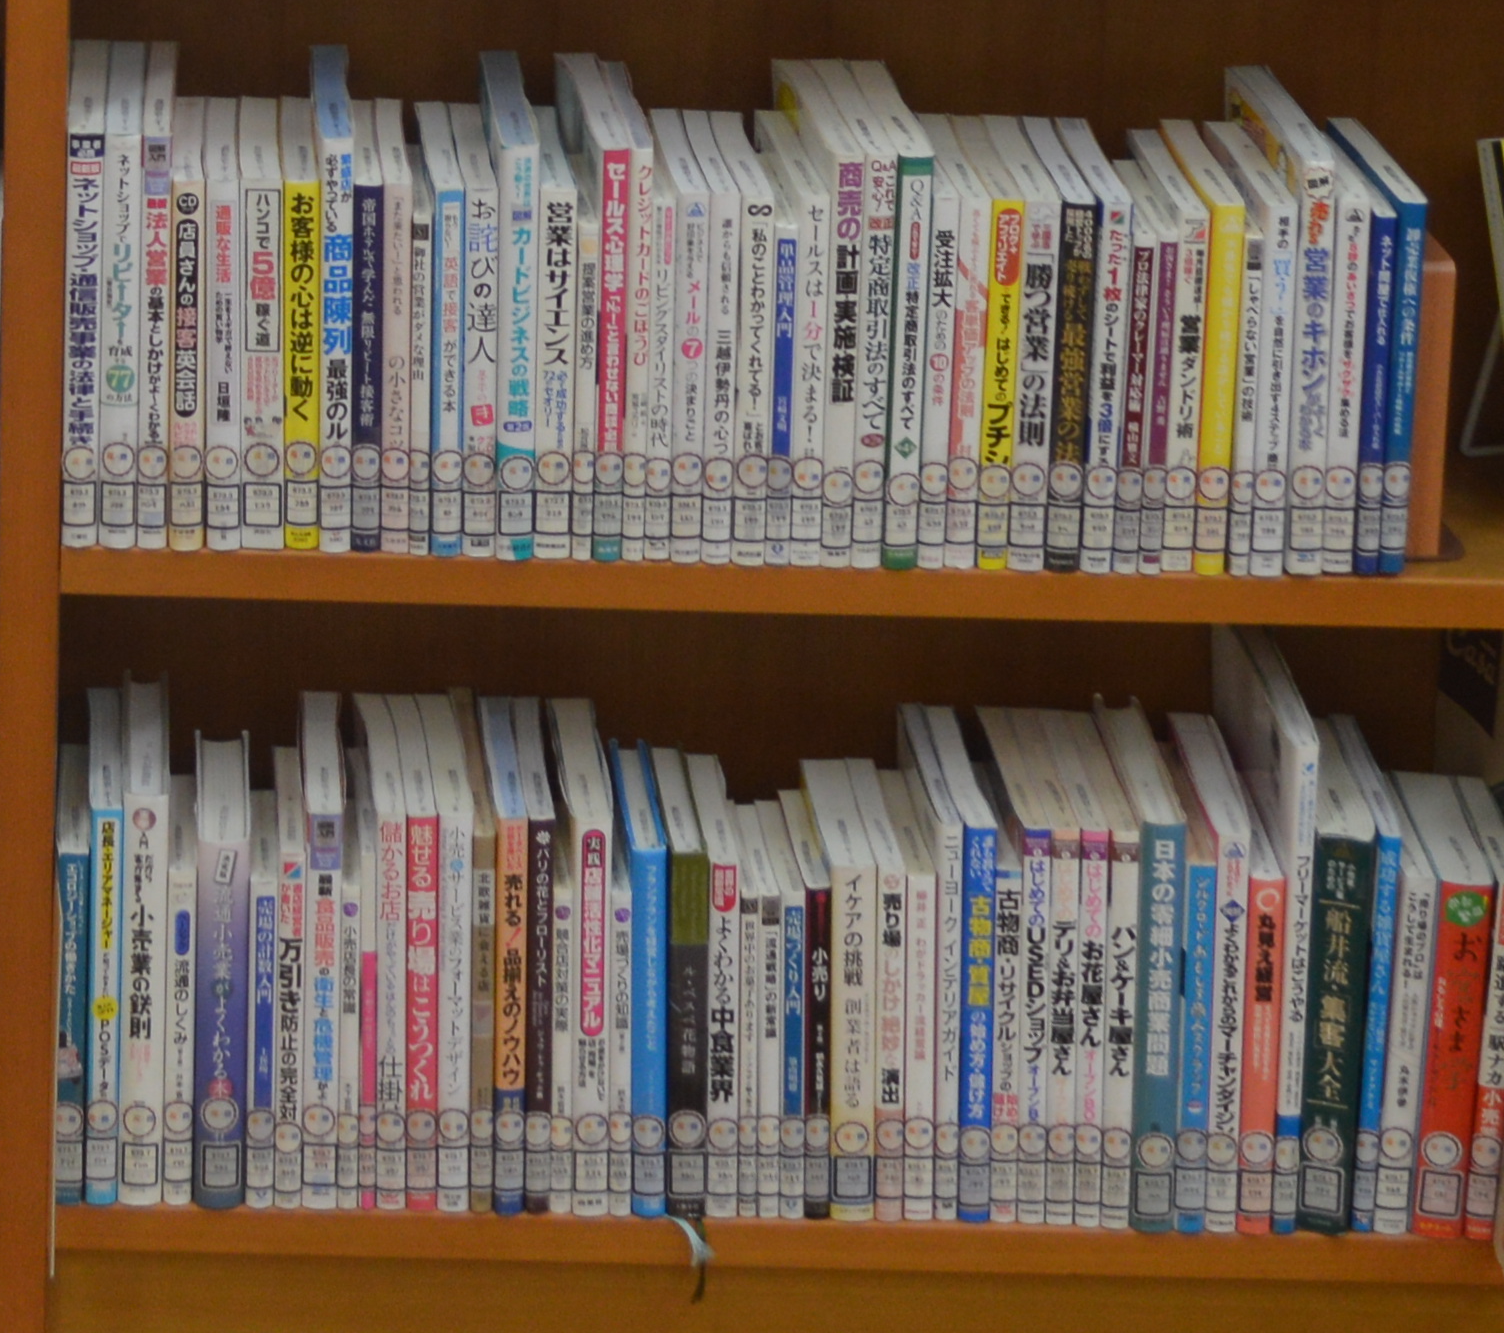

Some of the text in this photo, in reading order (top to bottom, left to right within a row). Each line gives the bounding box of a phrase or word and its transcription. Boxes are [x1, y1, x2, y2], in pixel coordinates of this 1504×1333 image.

[290, 193, 315, 422] お客様の心は逆に動く
[543, 202, 573, 367] 営業はサイエンス
[130, 905, 153, 1039] 小売業の鉄則
[406, 825, 438, 1102] 魅せる売り場はこうつくれ
[709, 915, 735, 1103] よくわかる中食業界
[1146, 839, 1176, 1077] 日本の零細小売商業問題
